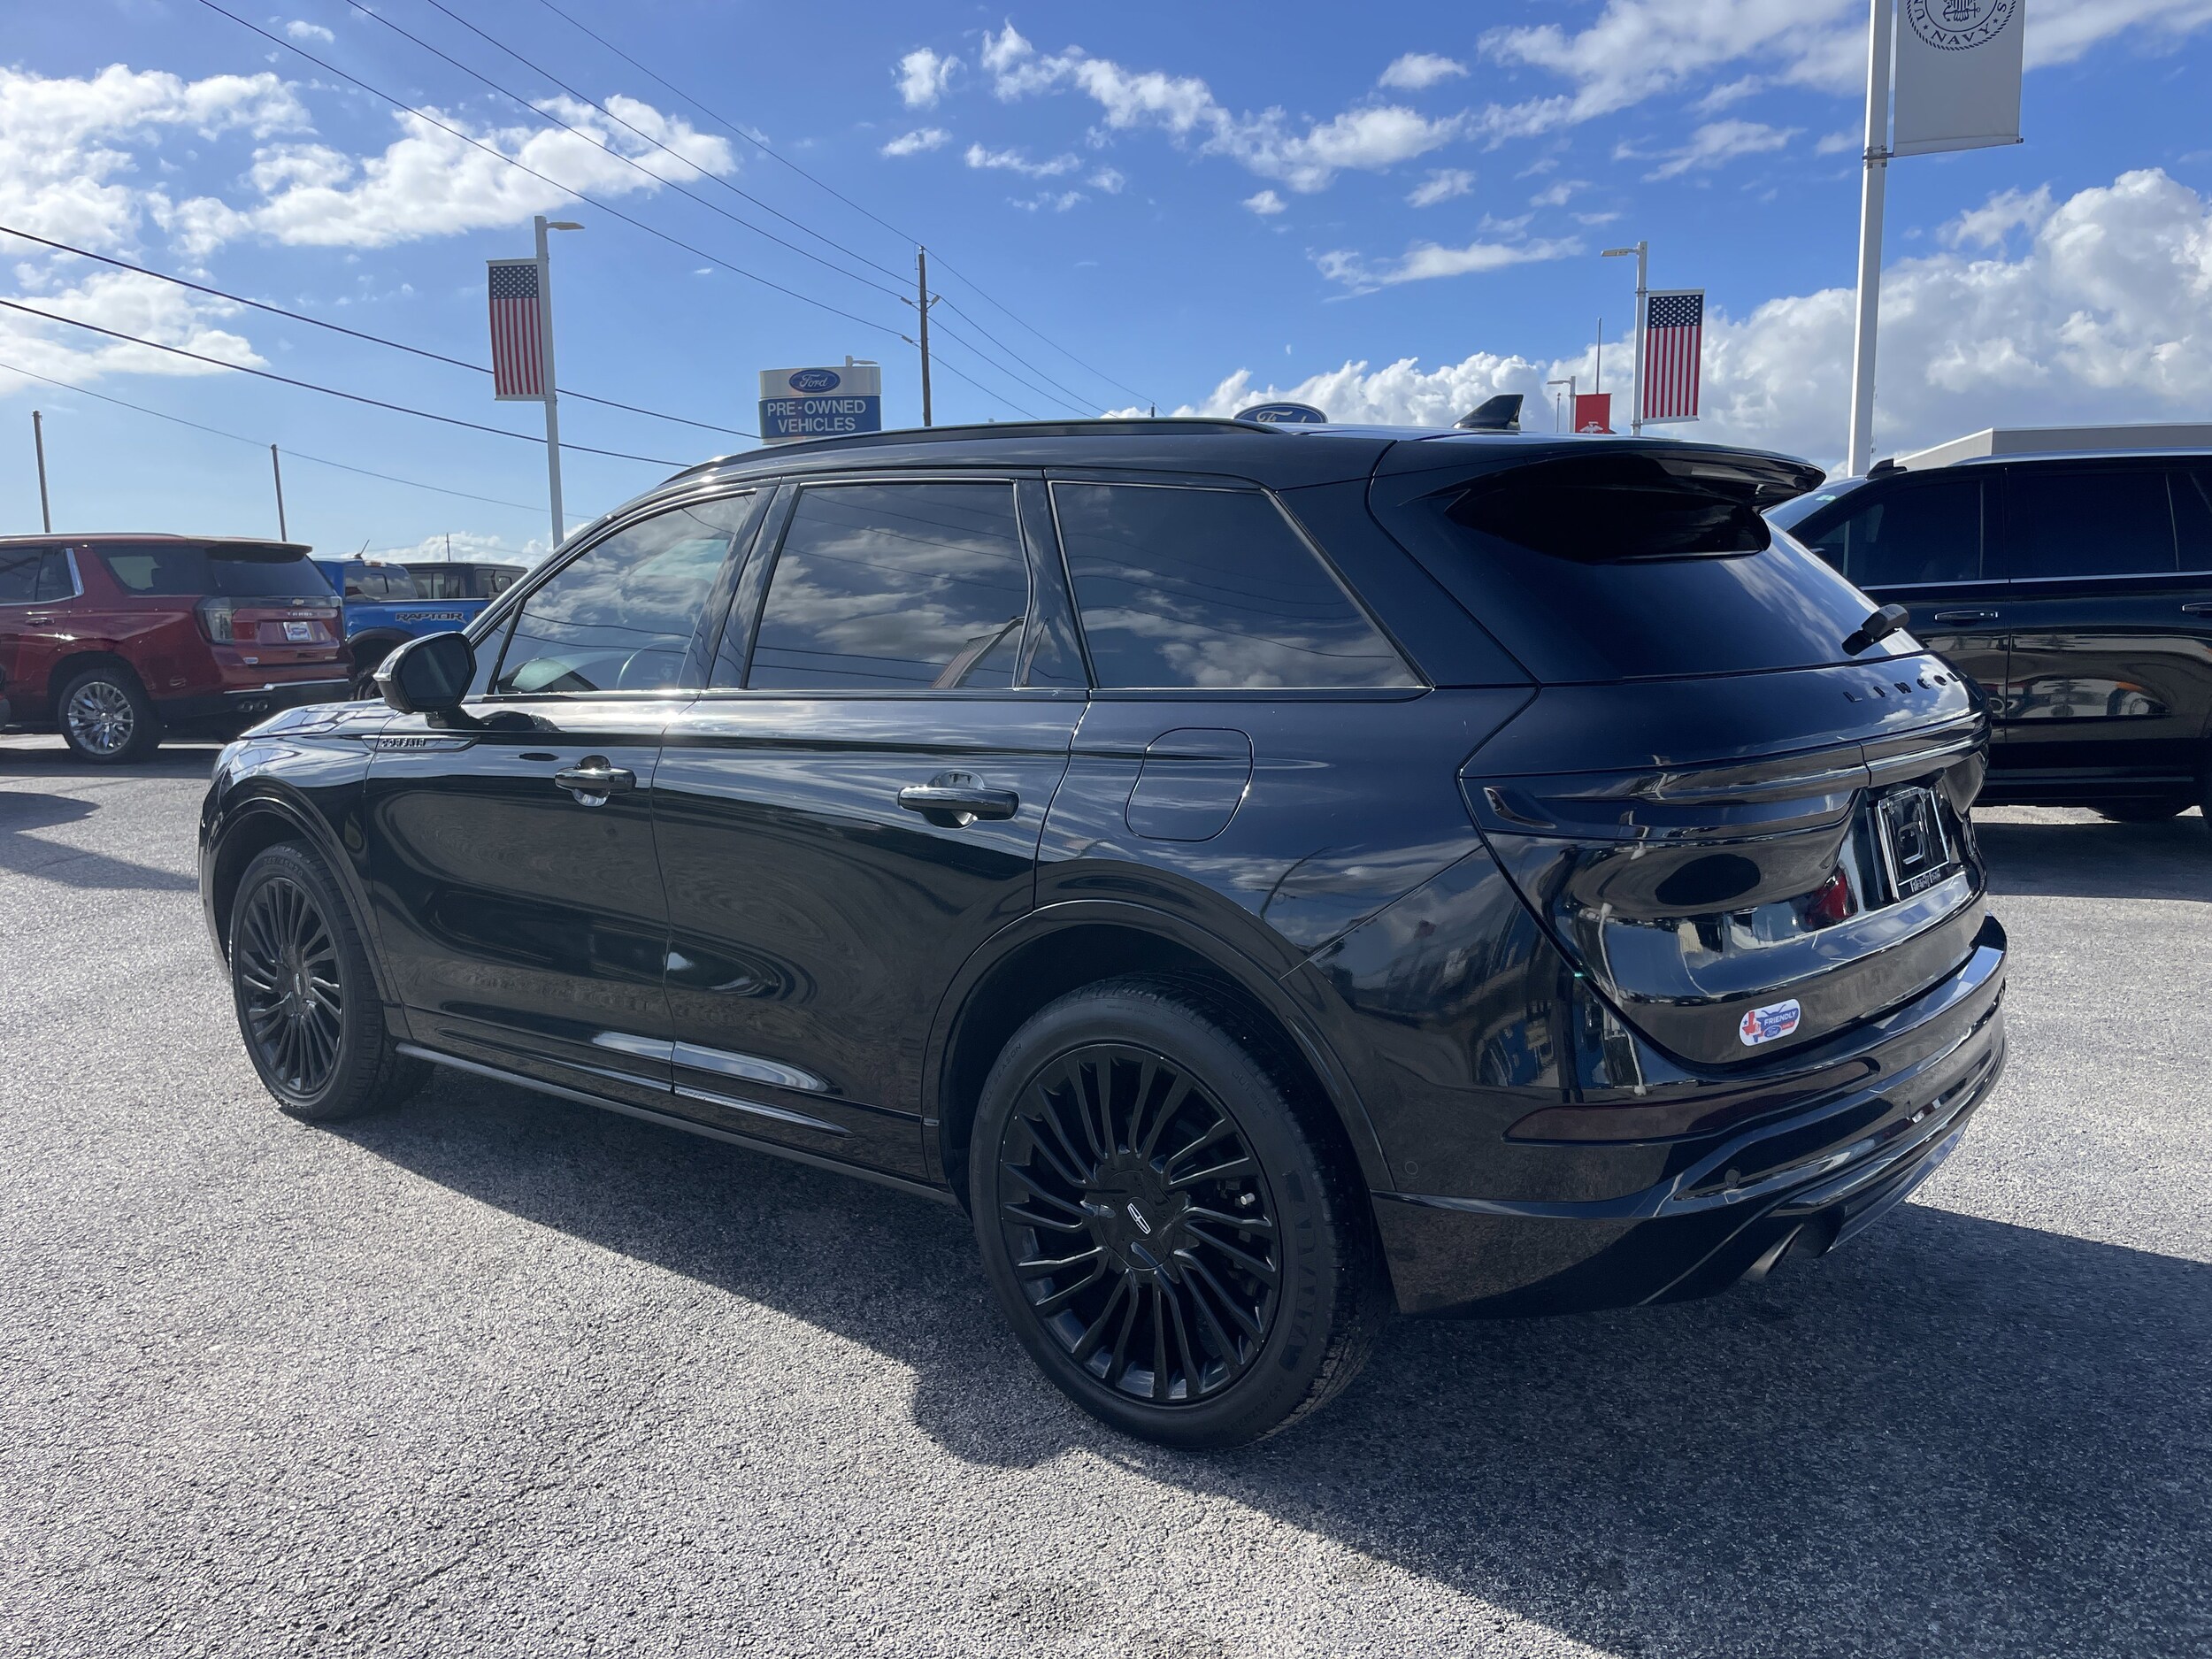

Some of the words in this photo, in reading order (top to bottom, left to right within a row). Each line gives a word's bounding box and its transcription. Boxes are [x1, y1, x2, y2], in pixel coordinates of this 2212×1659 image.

[1931, 22, 1990, 45] NAVY
[799, 373, 828, 388] Ford
[778, 417, 856, 434] VEHICLES
[395, 611, 467, 625] RAPTOR
[1842, 672, 1962, 703] LINCOL
[1763, 1010, 1797, 1026] FRIENDLY
